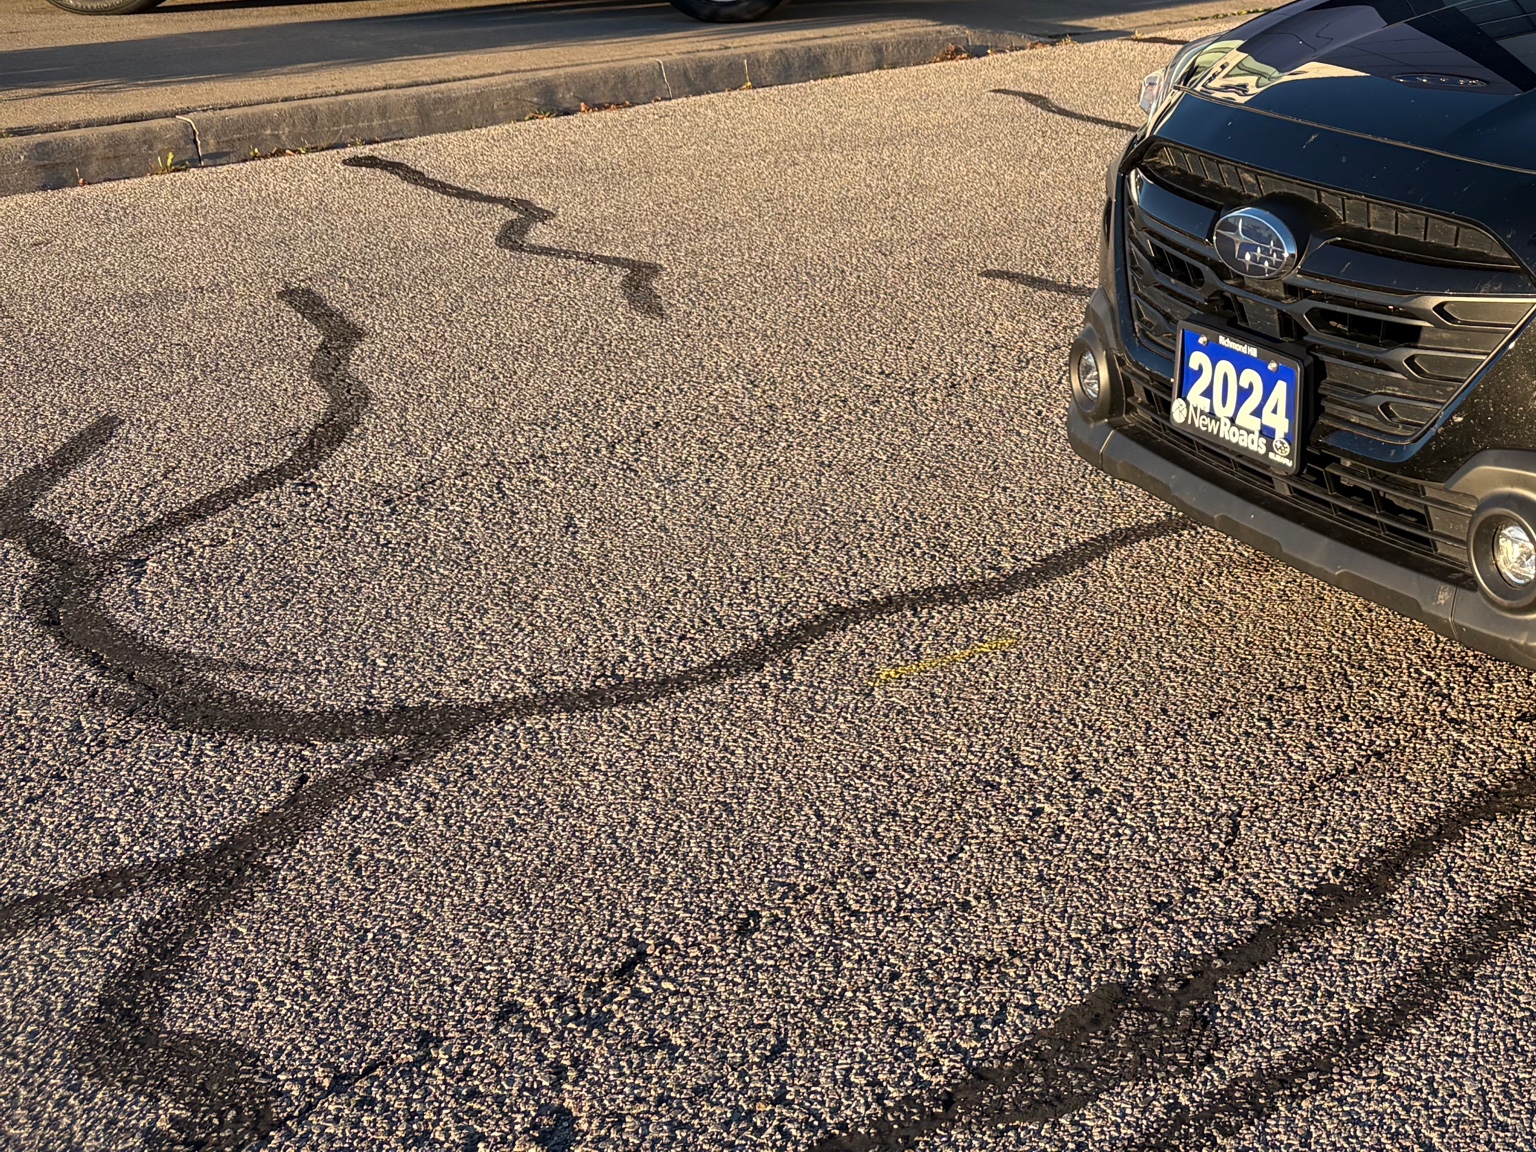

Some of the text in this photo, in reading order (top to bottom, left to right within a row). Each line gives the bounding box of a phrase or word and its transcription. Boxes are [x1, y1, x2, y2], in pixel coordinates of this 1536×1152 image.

[1219, 335, 1257, 357] Richmond Hill
[1186, 351, 1289, 440] 2024
